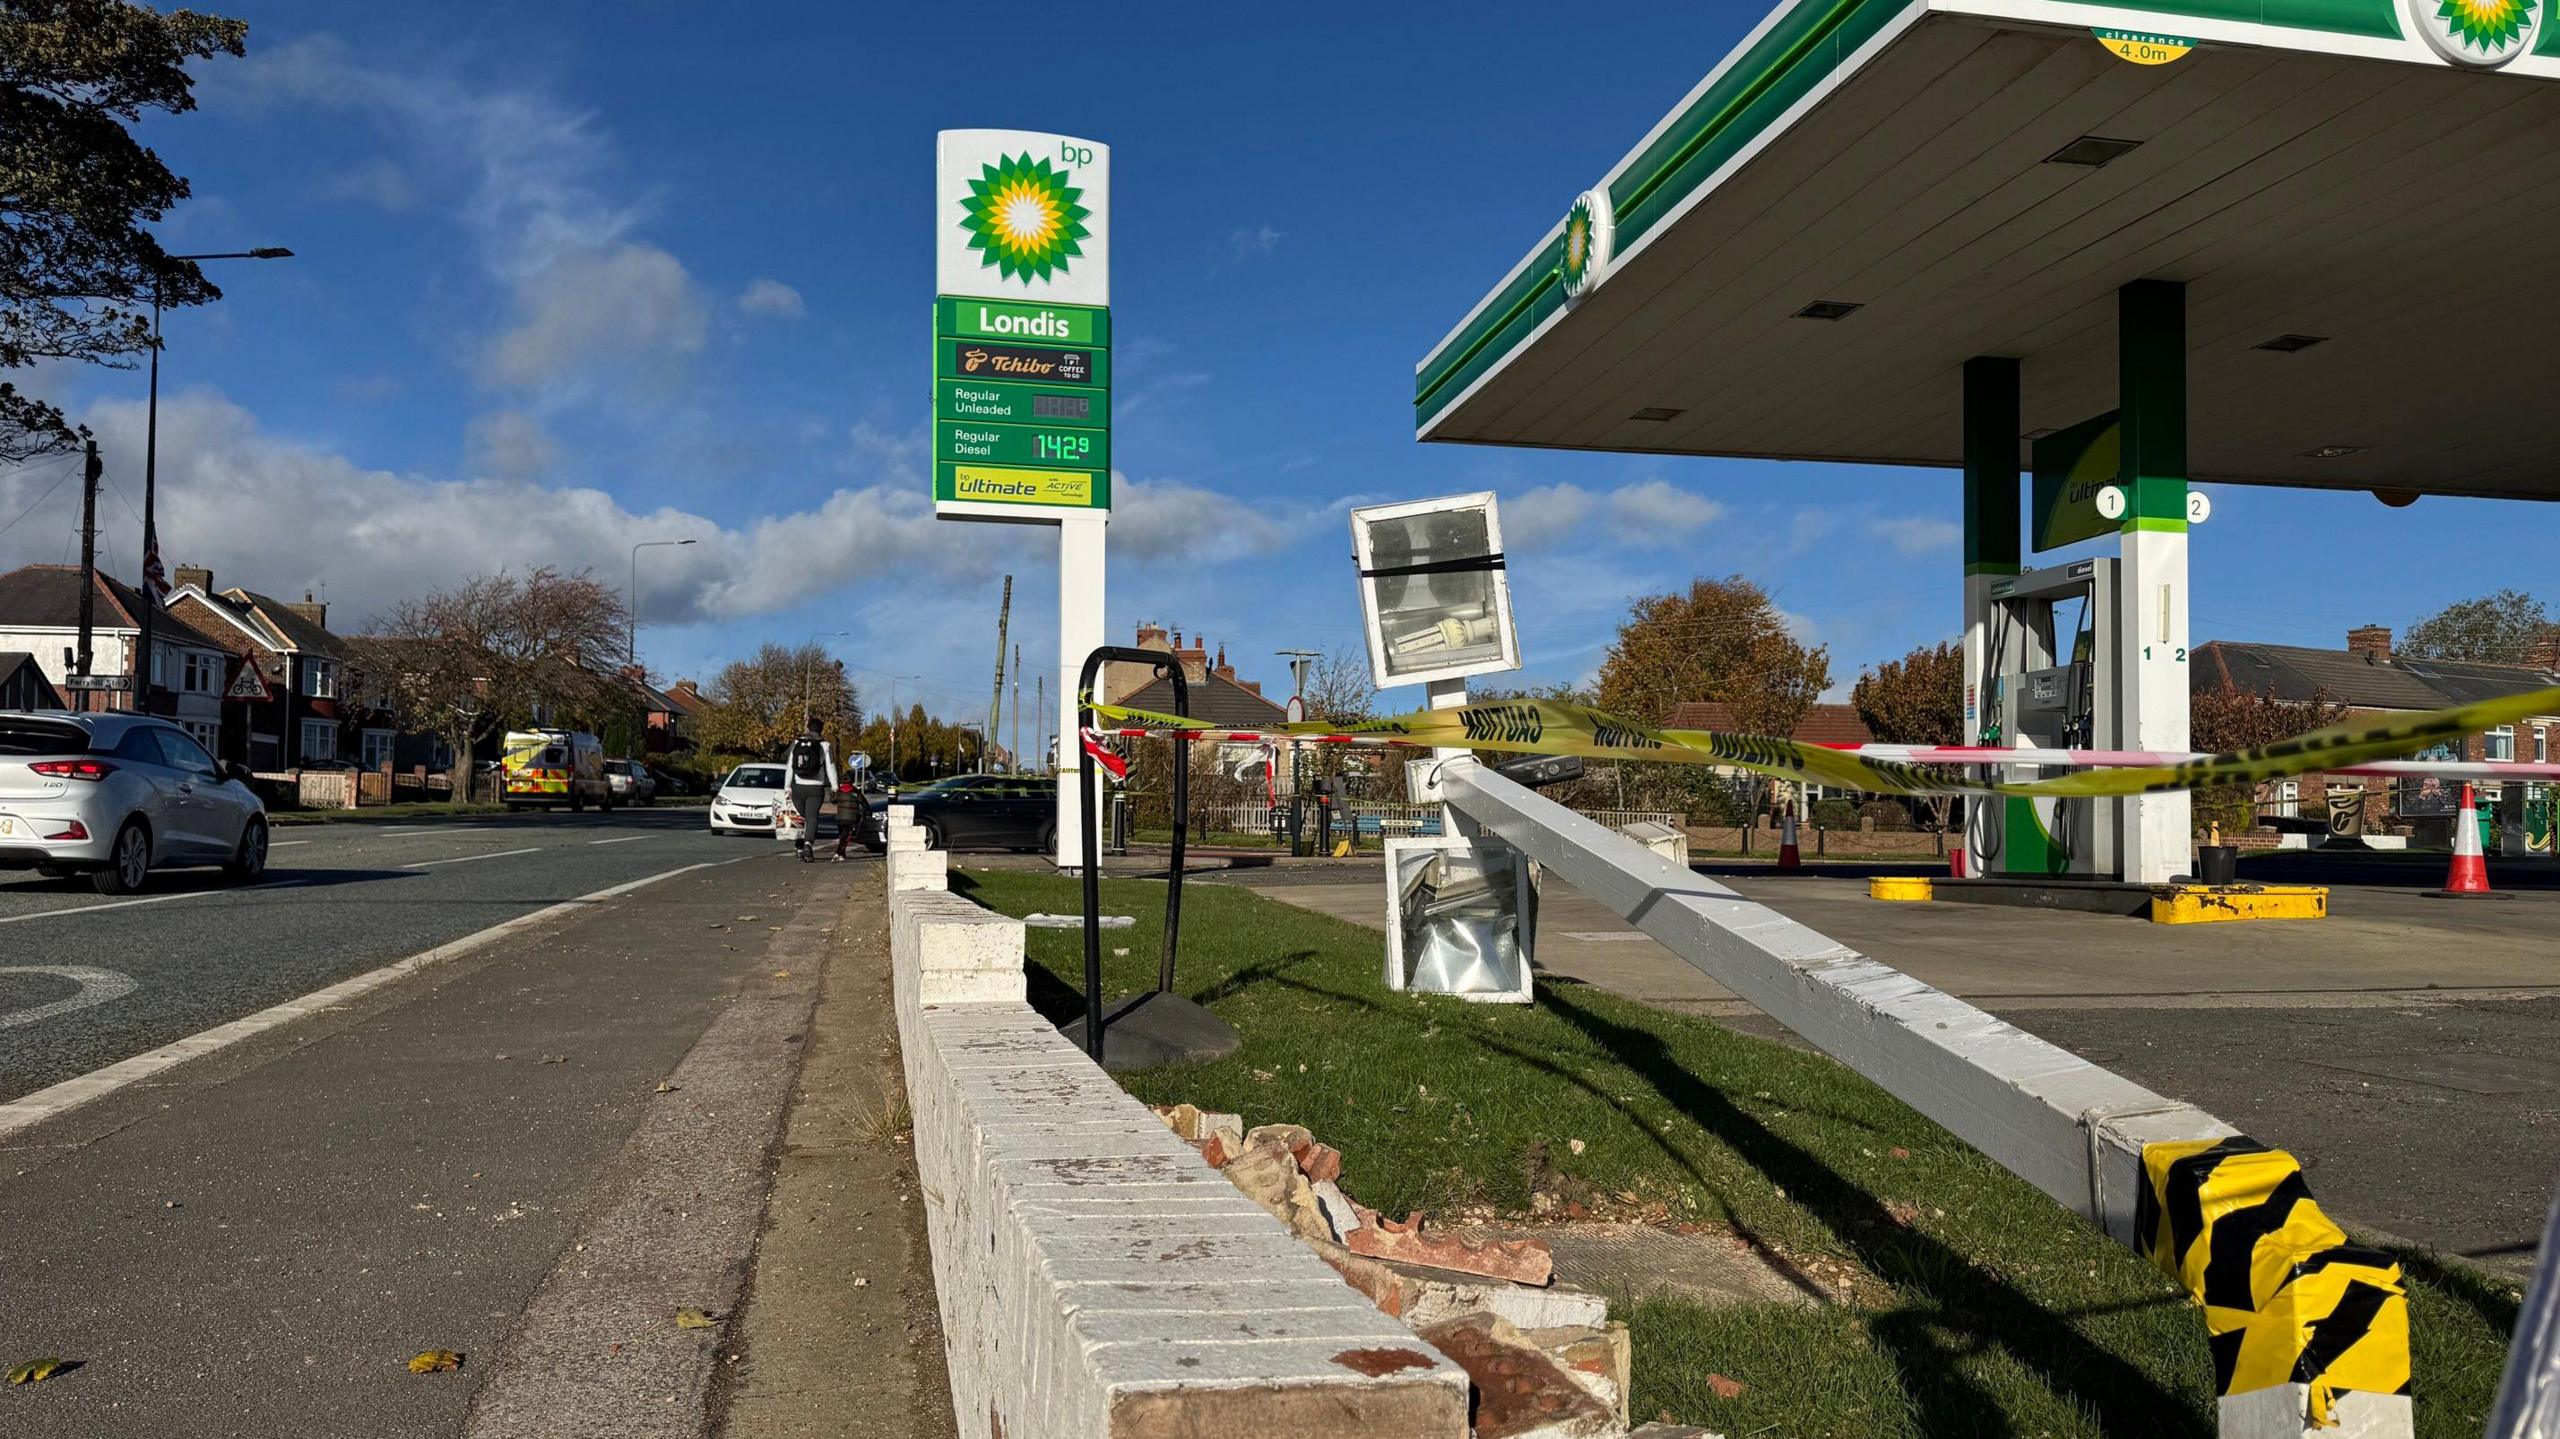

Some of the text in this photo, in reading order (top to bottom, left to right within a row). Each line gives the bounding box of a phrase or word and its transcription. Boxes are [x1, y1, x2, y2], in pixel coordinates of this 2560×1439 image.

[2106, 31, 2184, 46] clearance
[2120, 43, 2167, 60] 4.0m
[1061, 140, 1093, 169] bp
[980, 307, 1069, 337] Londis
[991, 355, 1056, 375] Tchibo
[1058, 365, 1085, 374] COFFEE
[955, 388, 1000, 402] Regular
[955, 402, 1011, 416] Unleaded
[955, 429, 1000, 443] Regular
[955, 443, 991, 455] Diesel
[960, 478, 1037, 496] ultimate
[2108, 495, 2115, 511] 1
[2191, 499, 2201, 516] 2
[2143, 646, 2151, 661] 1
[2175, 648, 2186, 662] 2
